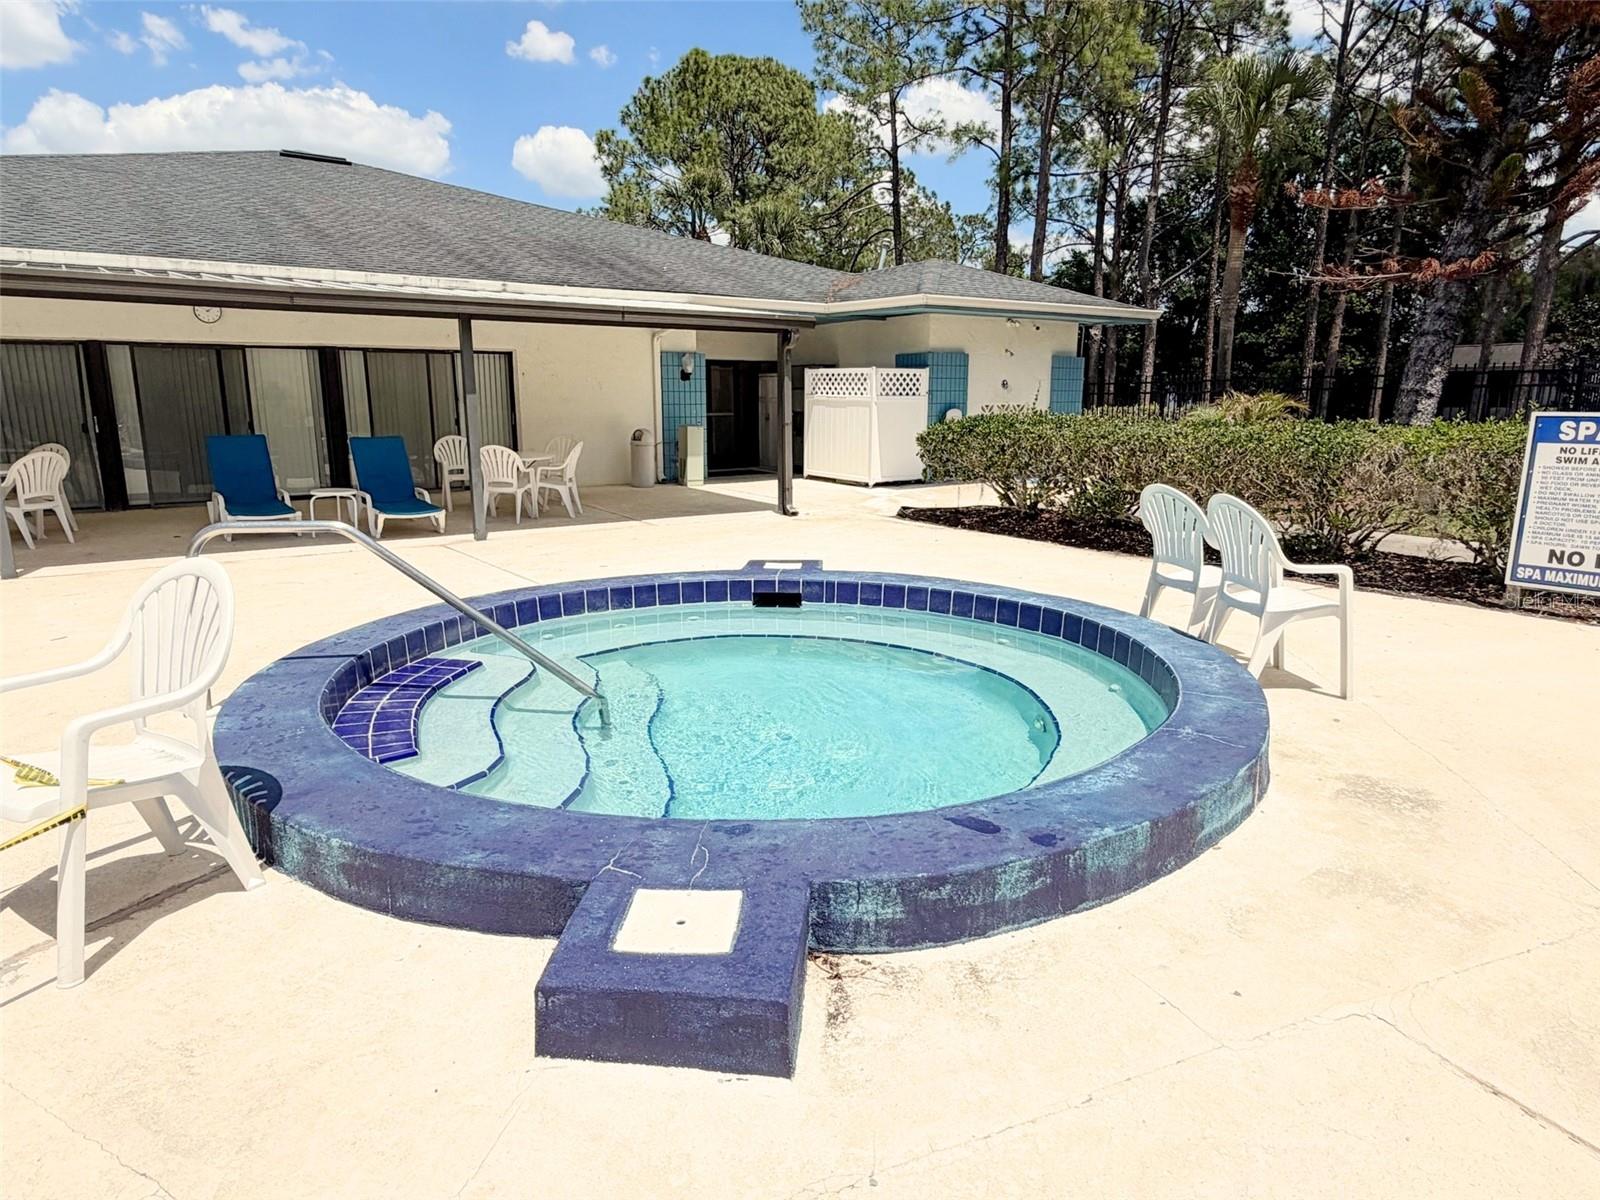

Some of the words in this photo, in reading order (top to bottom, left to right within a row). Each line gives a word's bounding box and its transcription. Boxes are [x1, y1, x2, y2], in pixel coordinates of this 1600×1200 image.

[1560, 446, 1577, 455] NO
[1581, 447, 1600, 456] LIF
[1555, 456, 1588, 465] SWIM
[1547, 549, 1585, 567] NO
[1516, 566, 1541, 580] SPA
[1544, 570, 1600, 588] MAXIMU
